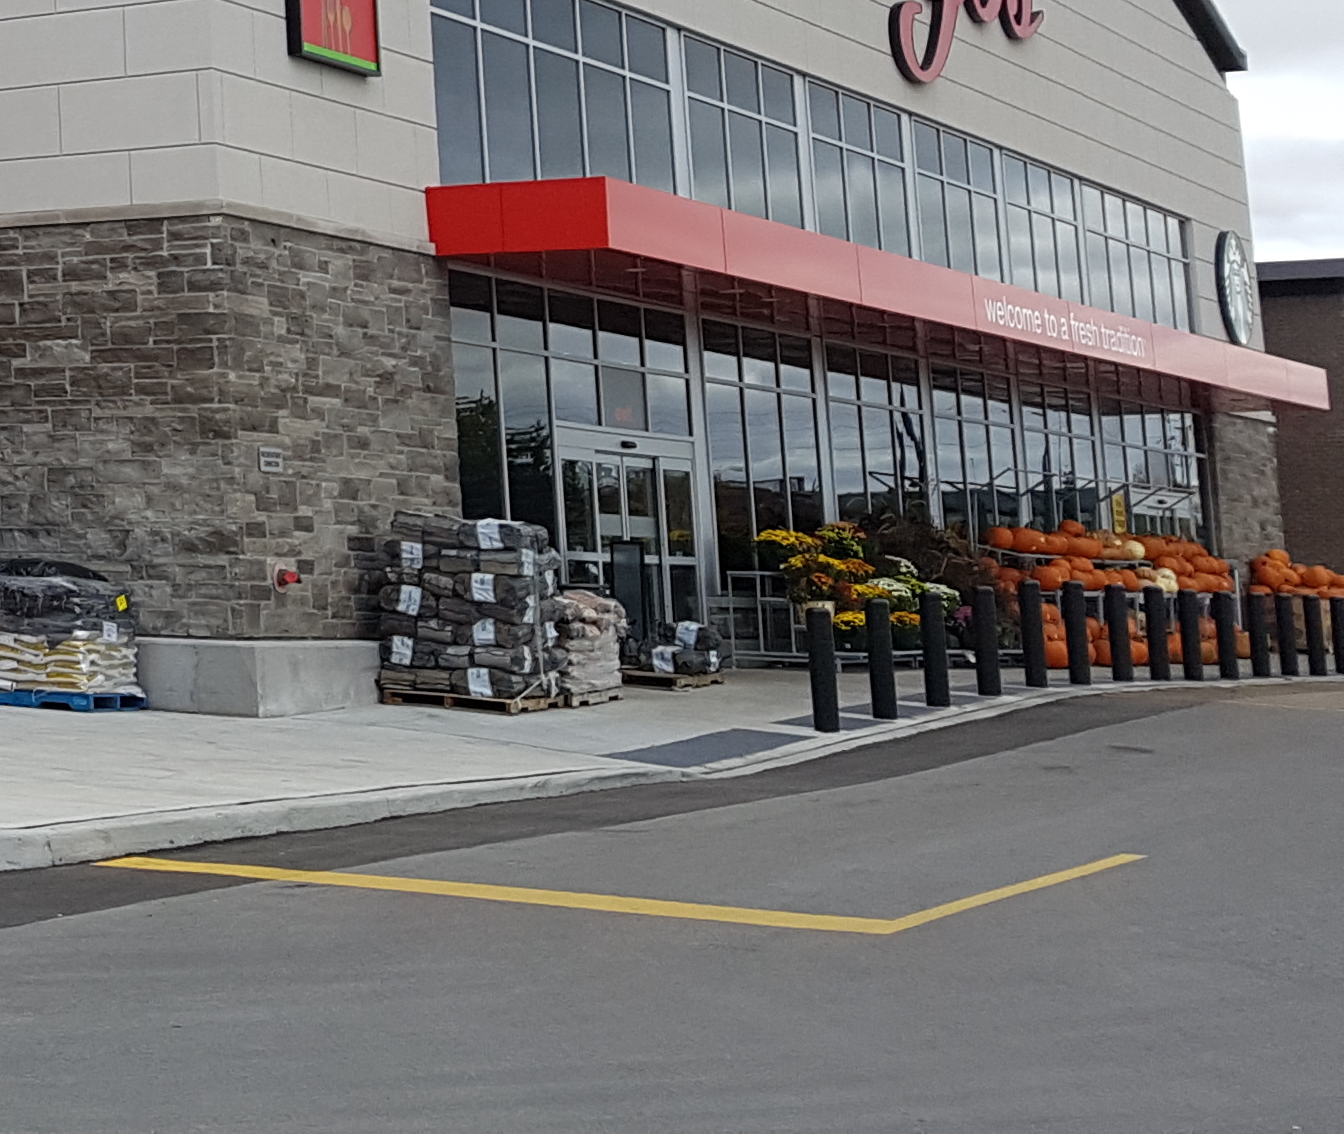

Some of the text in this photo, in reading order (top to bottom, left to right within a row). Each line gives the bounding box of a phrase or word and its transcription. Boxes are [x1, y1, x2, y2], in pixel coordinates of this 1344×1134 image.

[984, 296, 1042, 334] welcome
[1044, 308, 1058, 337] to
[1061, 317, 1069, 340] a
[1070, 312, 1100, 347] fresh
